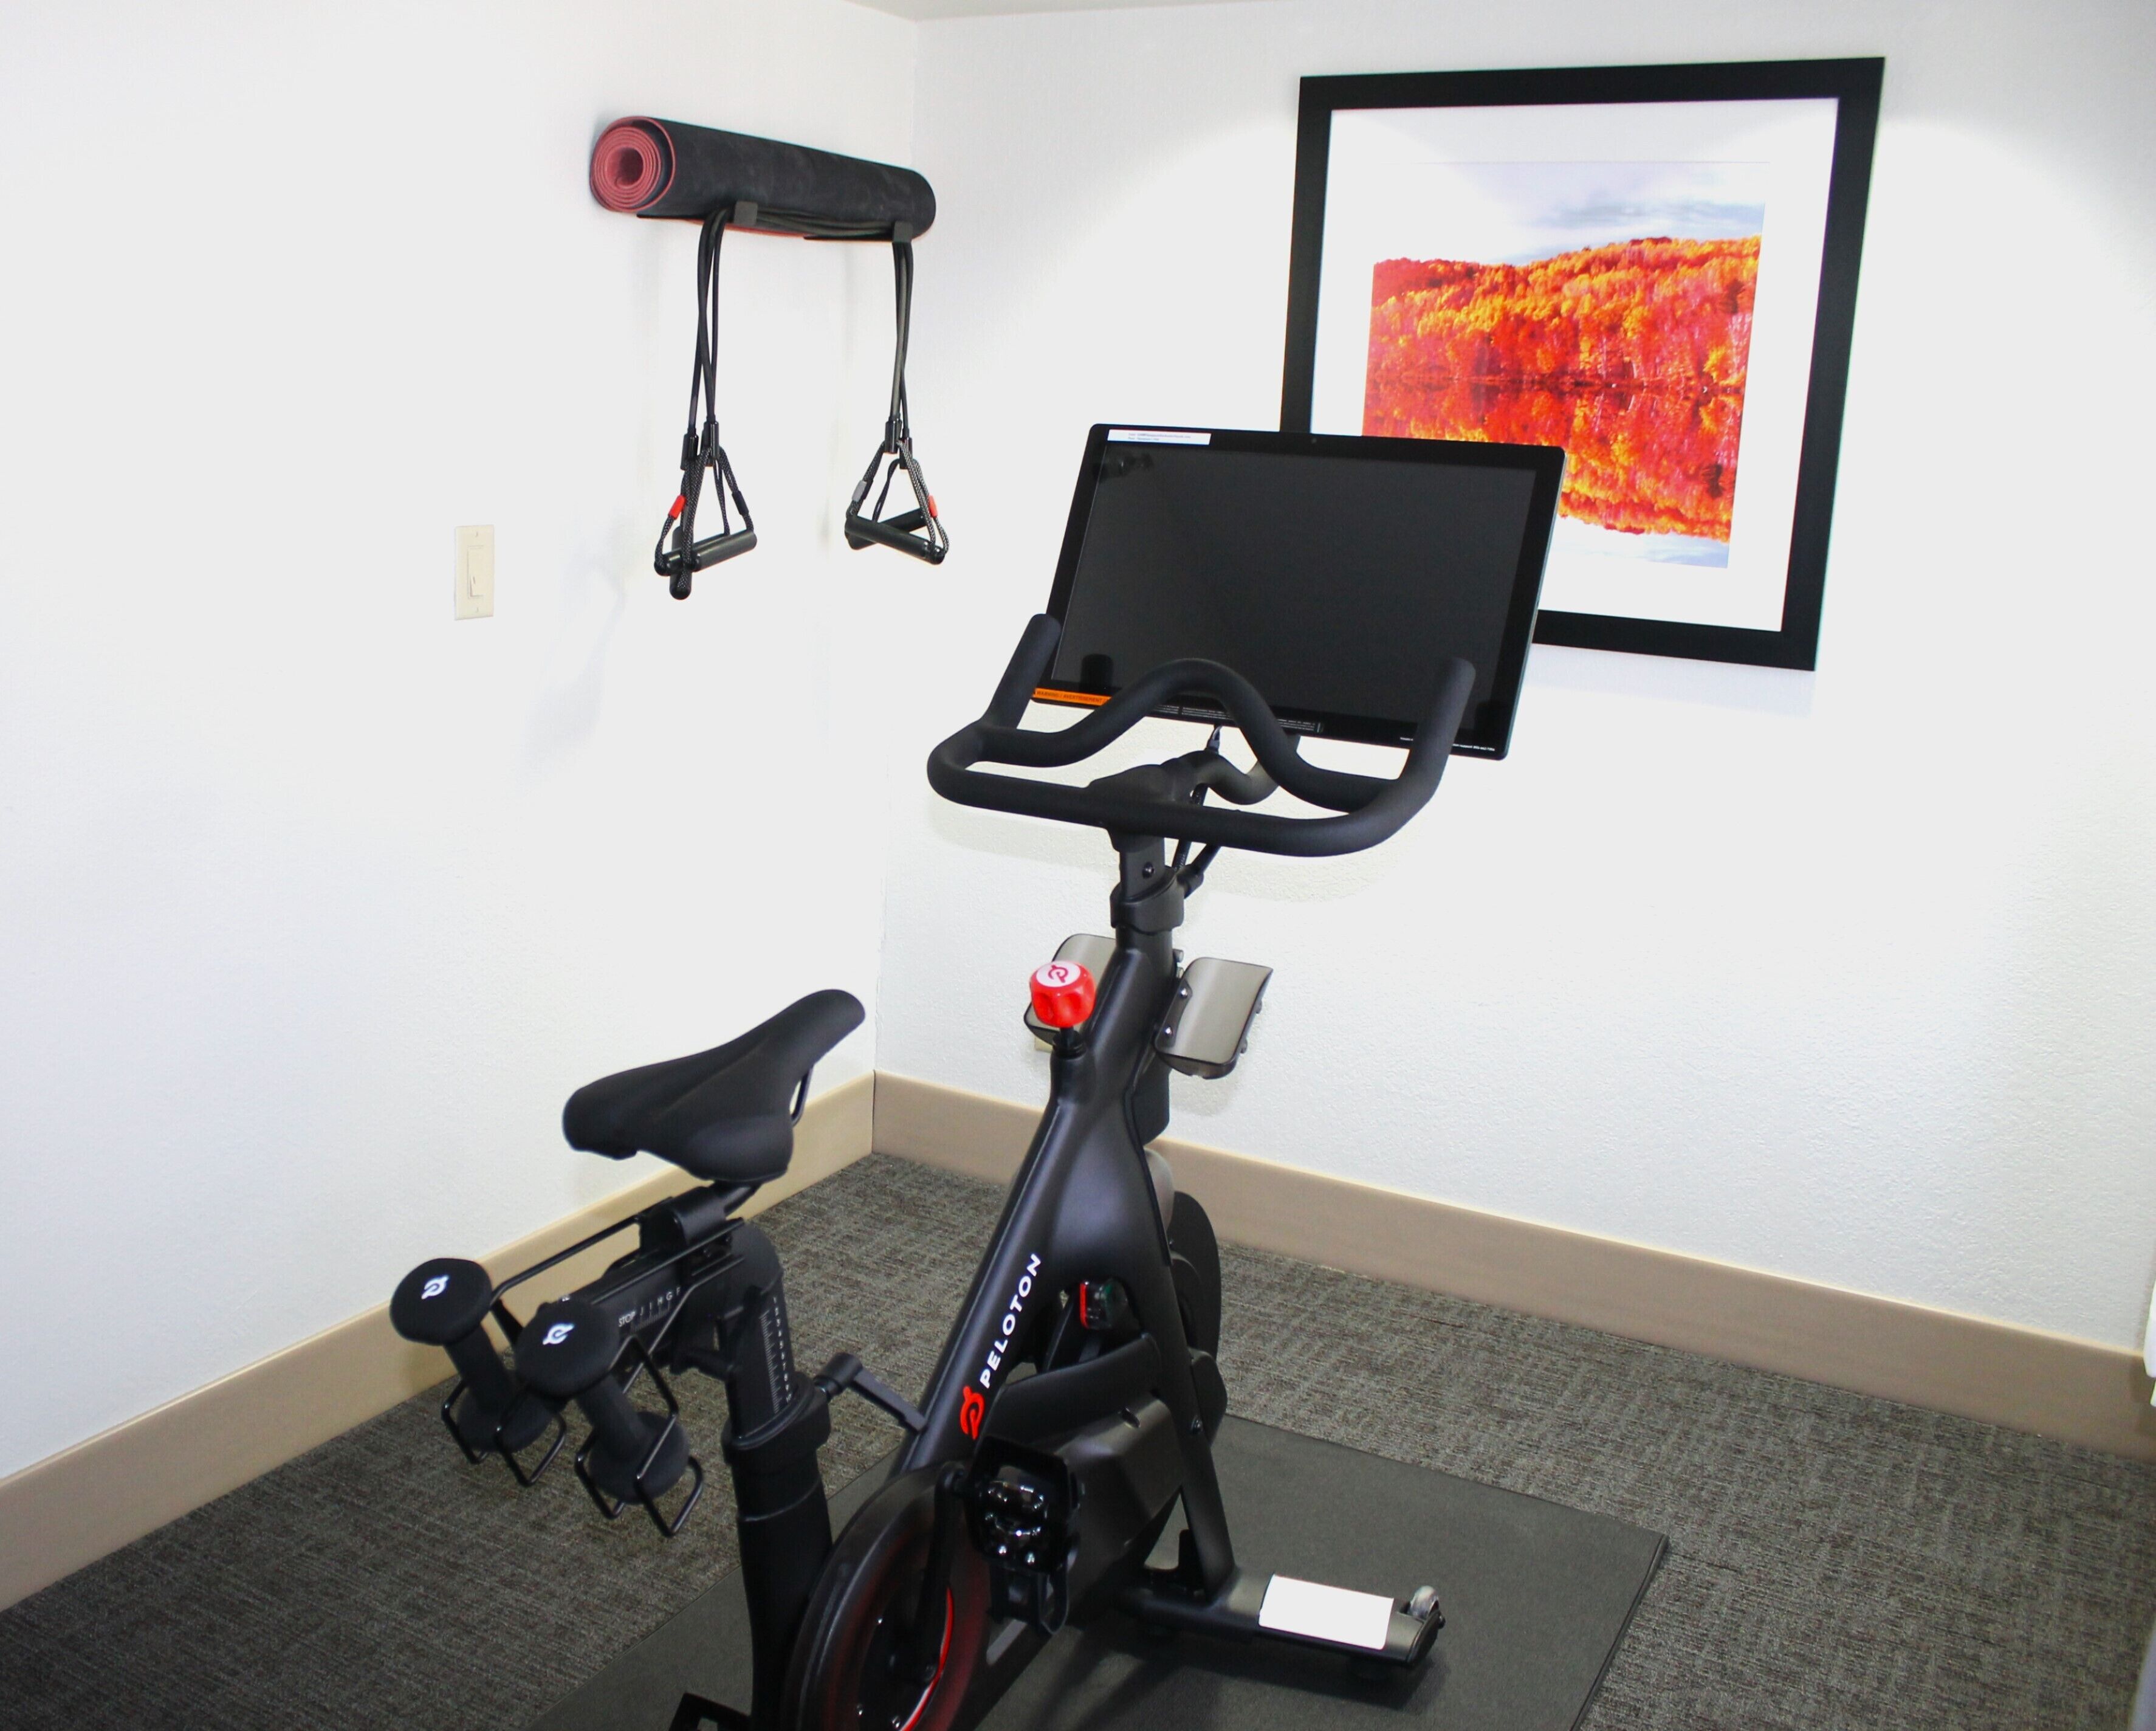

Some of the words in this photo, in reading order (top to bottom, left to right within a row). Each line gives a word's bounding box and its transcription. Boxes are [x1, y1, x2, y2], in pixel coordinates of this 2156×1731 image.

[618, 1310, 636, 1327] STOP
[666, 1291, 673, 1301] G
[980, 1253, 1042, 1389] PELOTON
